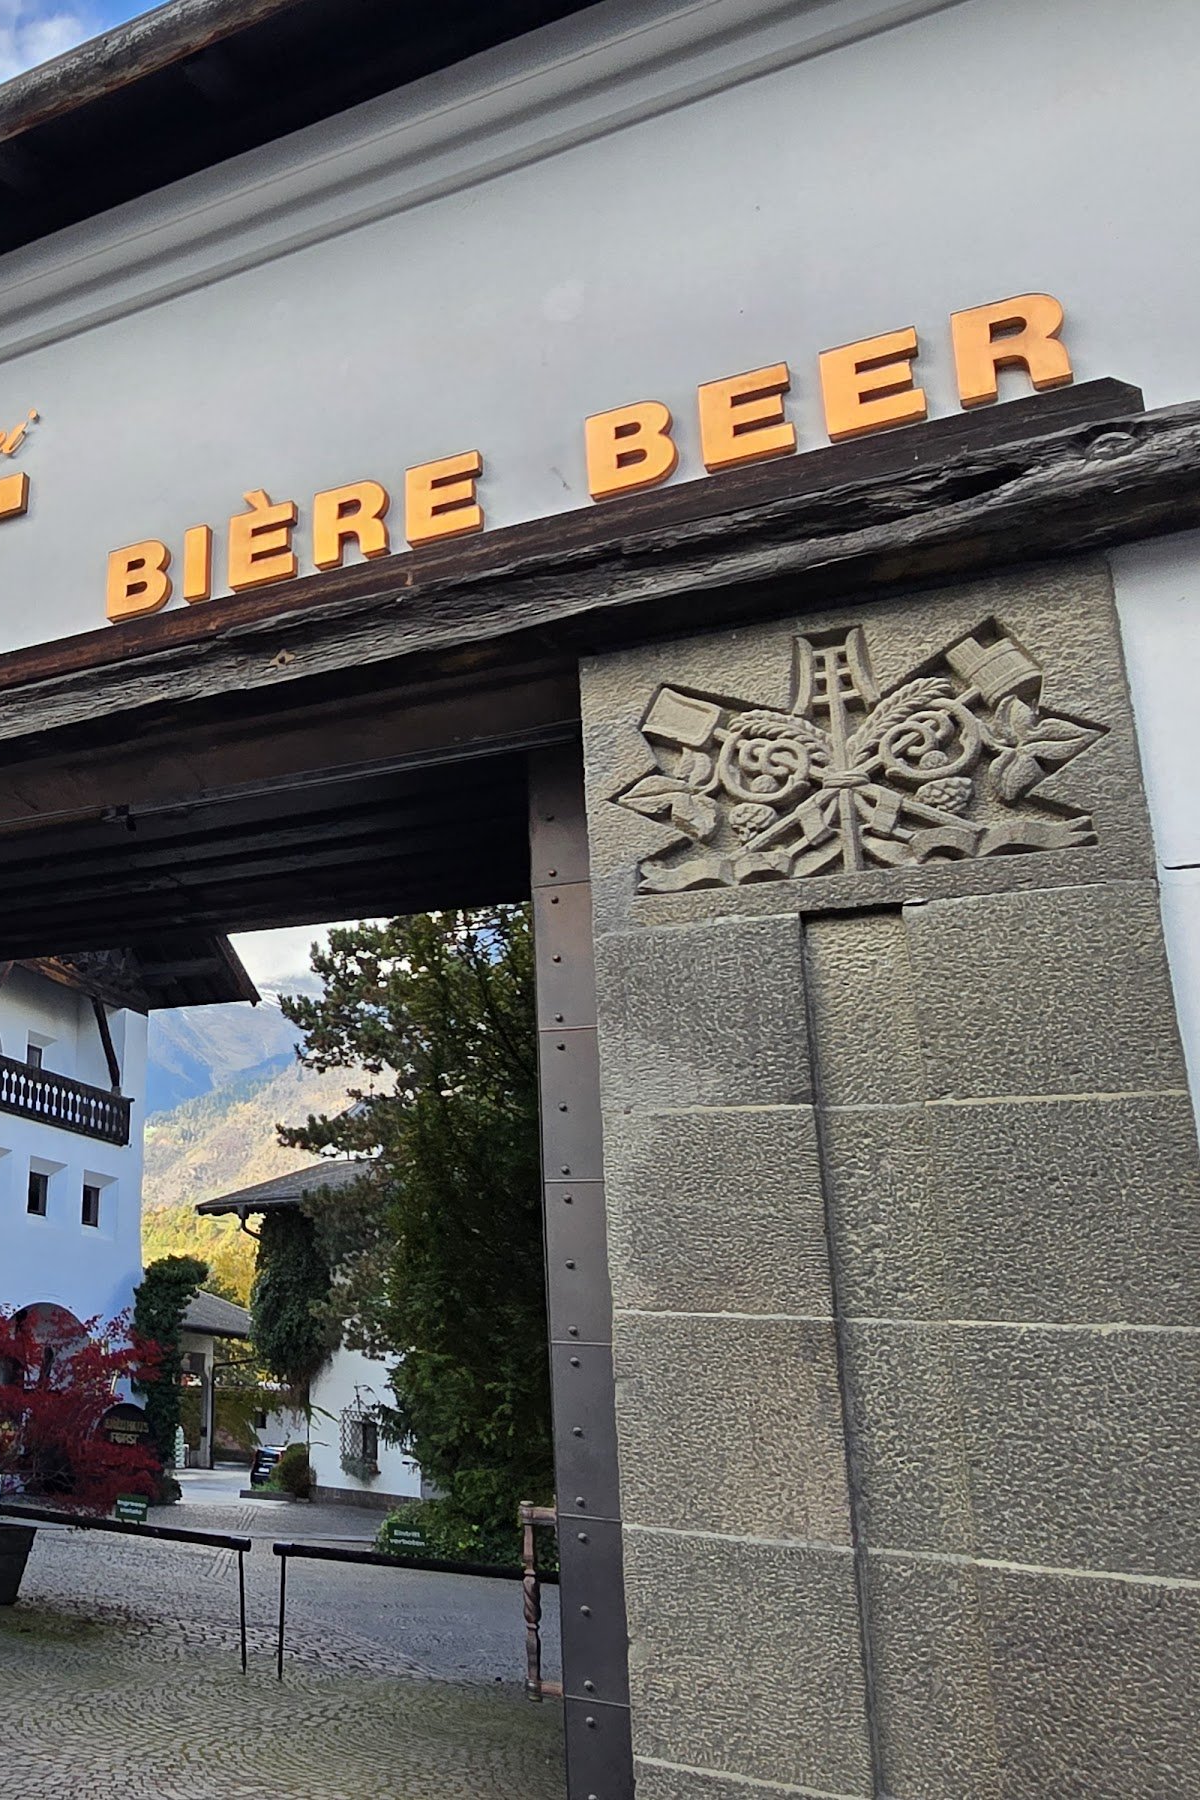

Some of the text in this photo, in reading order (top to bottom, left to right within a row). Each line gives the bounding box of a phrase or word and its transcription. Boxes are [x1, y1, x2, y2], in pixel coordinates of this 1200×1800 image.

[104, 291, 1074, 622] BIÈRE BEER
[110, 1431, 140, 1445] FORST
